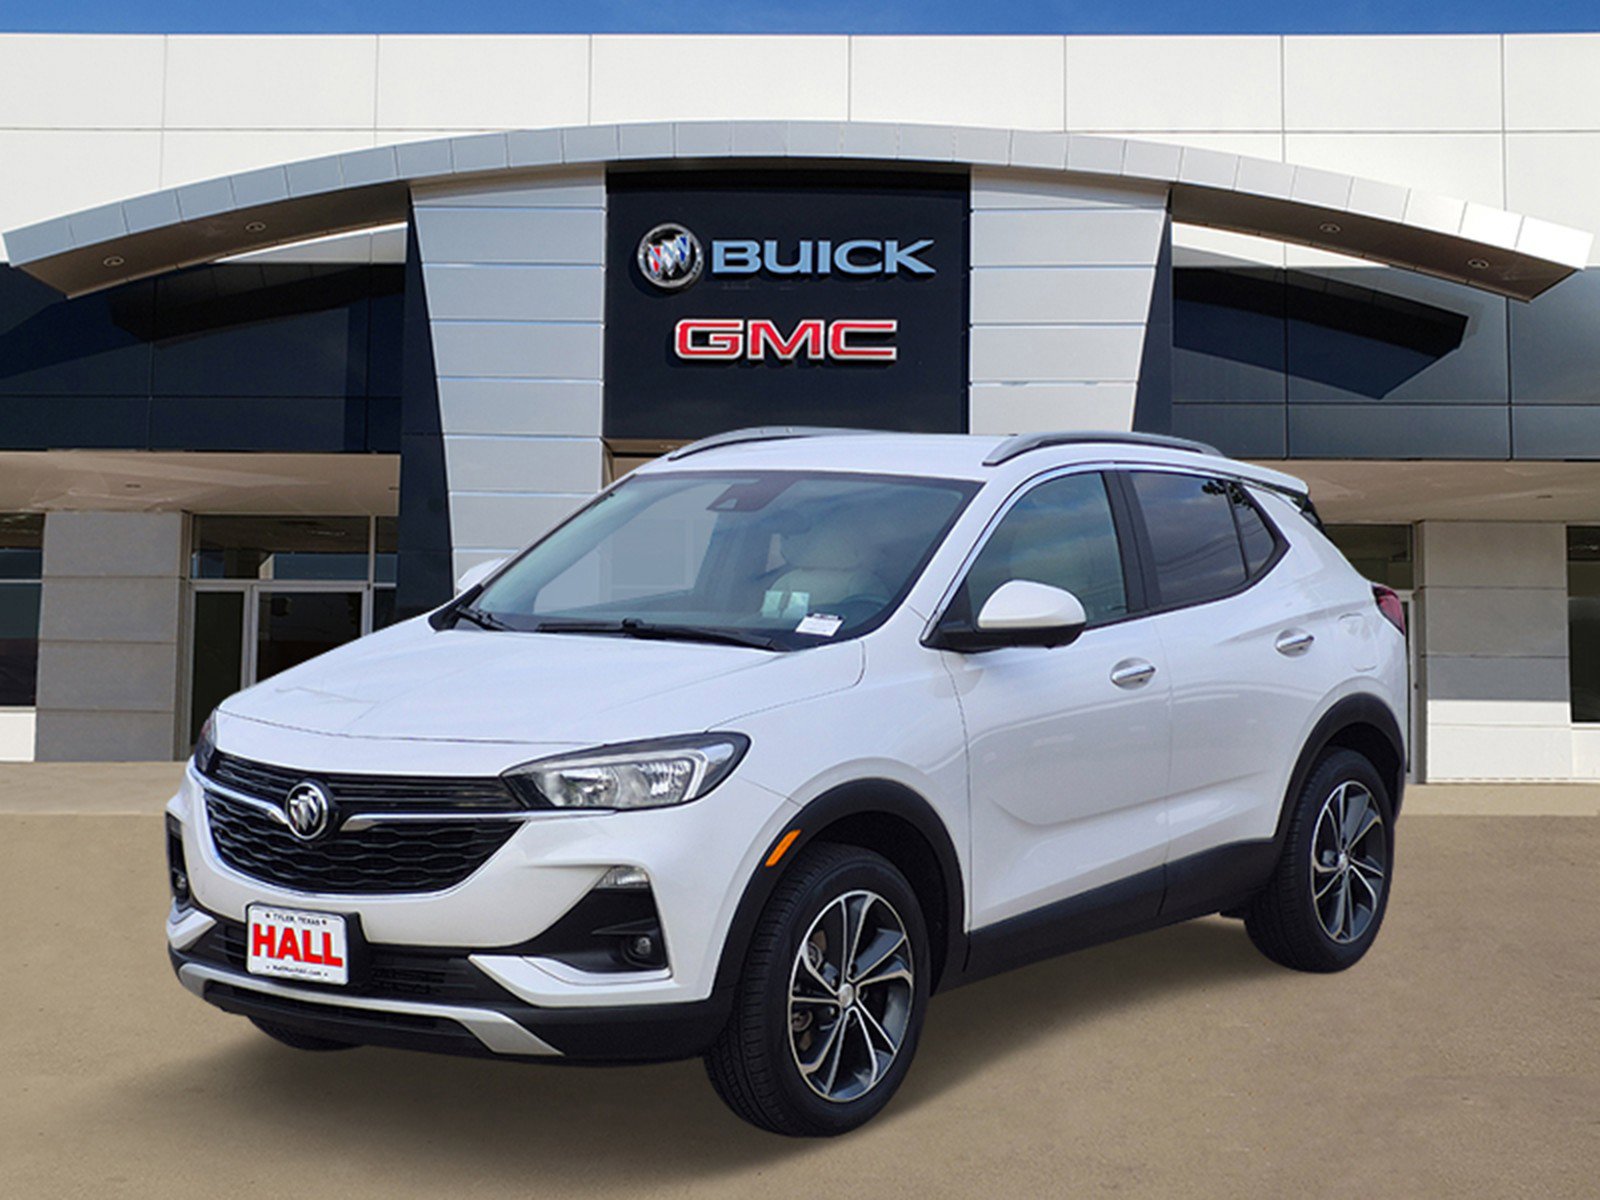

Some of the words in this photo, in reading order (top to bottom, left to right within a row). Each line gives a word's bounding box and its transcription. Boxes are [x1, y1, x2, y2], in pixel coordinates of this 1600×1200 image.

[712, 239, 937, 274] BUICK
[674, 318, 898, 361] GMC
[252, 923, 343, 968] HALL
